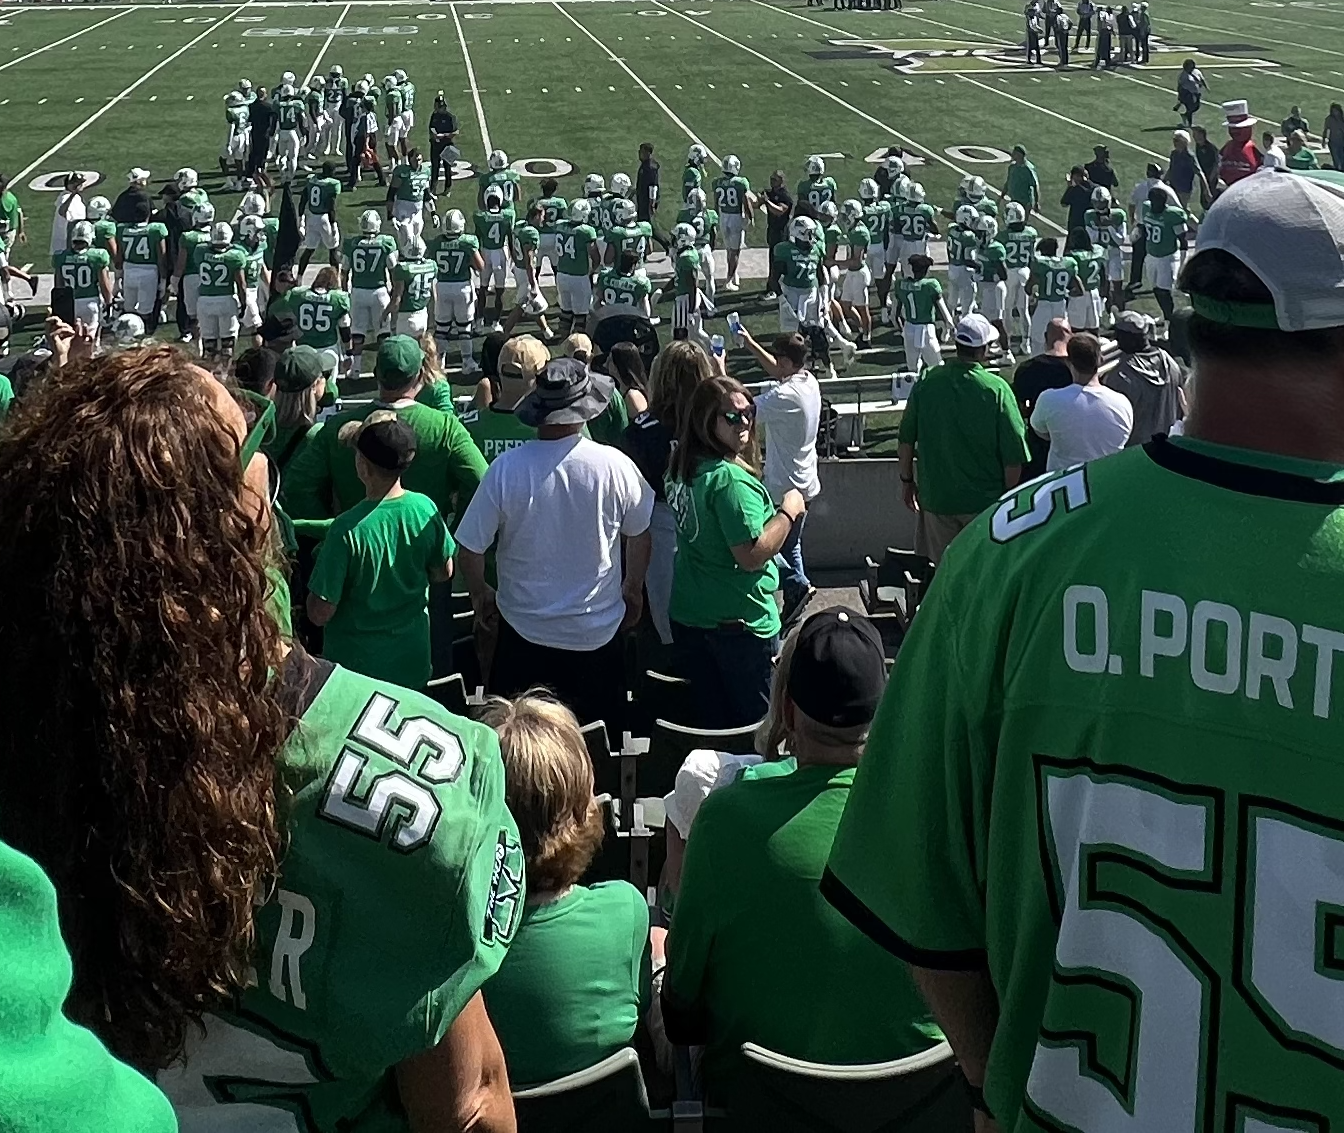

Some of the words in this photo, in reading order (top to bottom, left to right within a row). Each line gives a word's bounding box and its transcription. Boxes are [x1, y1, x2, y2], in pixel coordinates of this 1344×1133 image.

[310, 185, 321, 207] 8
[716, 187, 737, 208] 28
[488, 223, 501, 244] 4
[899, 215, 925, 236] 26
[122, 236, 150, 260] 74
[556, 234, 576, 260] 64
[1007, 242, 1030, 263] 25
[352, 248, 382, 273] 67
[436, 251, 465, 274] 57
[1087, 260, 1100, 284] 2
[61, 265, 91, 288] 50
[199, 263, 229, 287] 62
[1045, 270, 1069, 296] 19
[299, 303, 333, 332] 65
[907, 294, 918, 320] 1
[316, 692, 466, 854] 55
